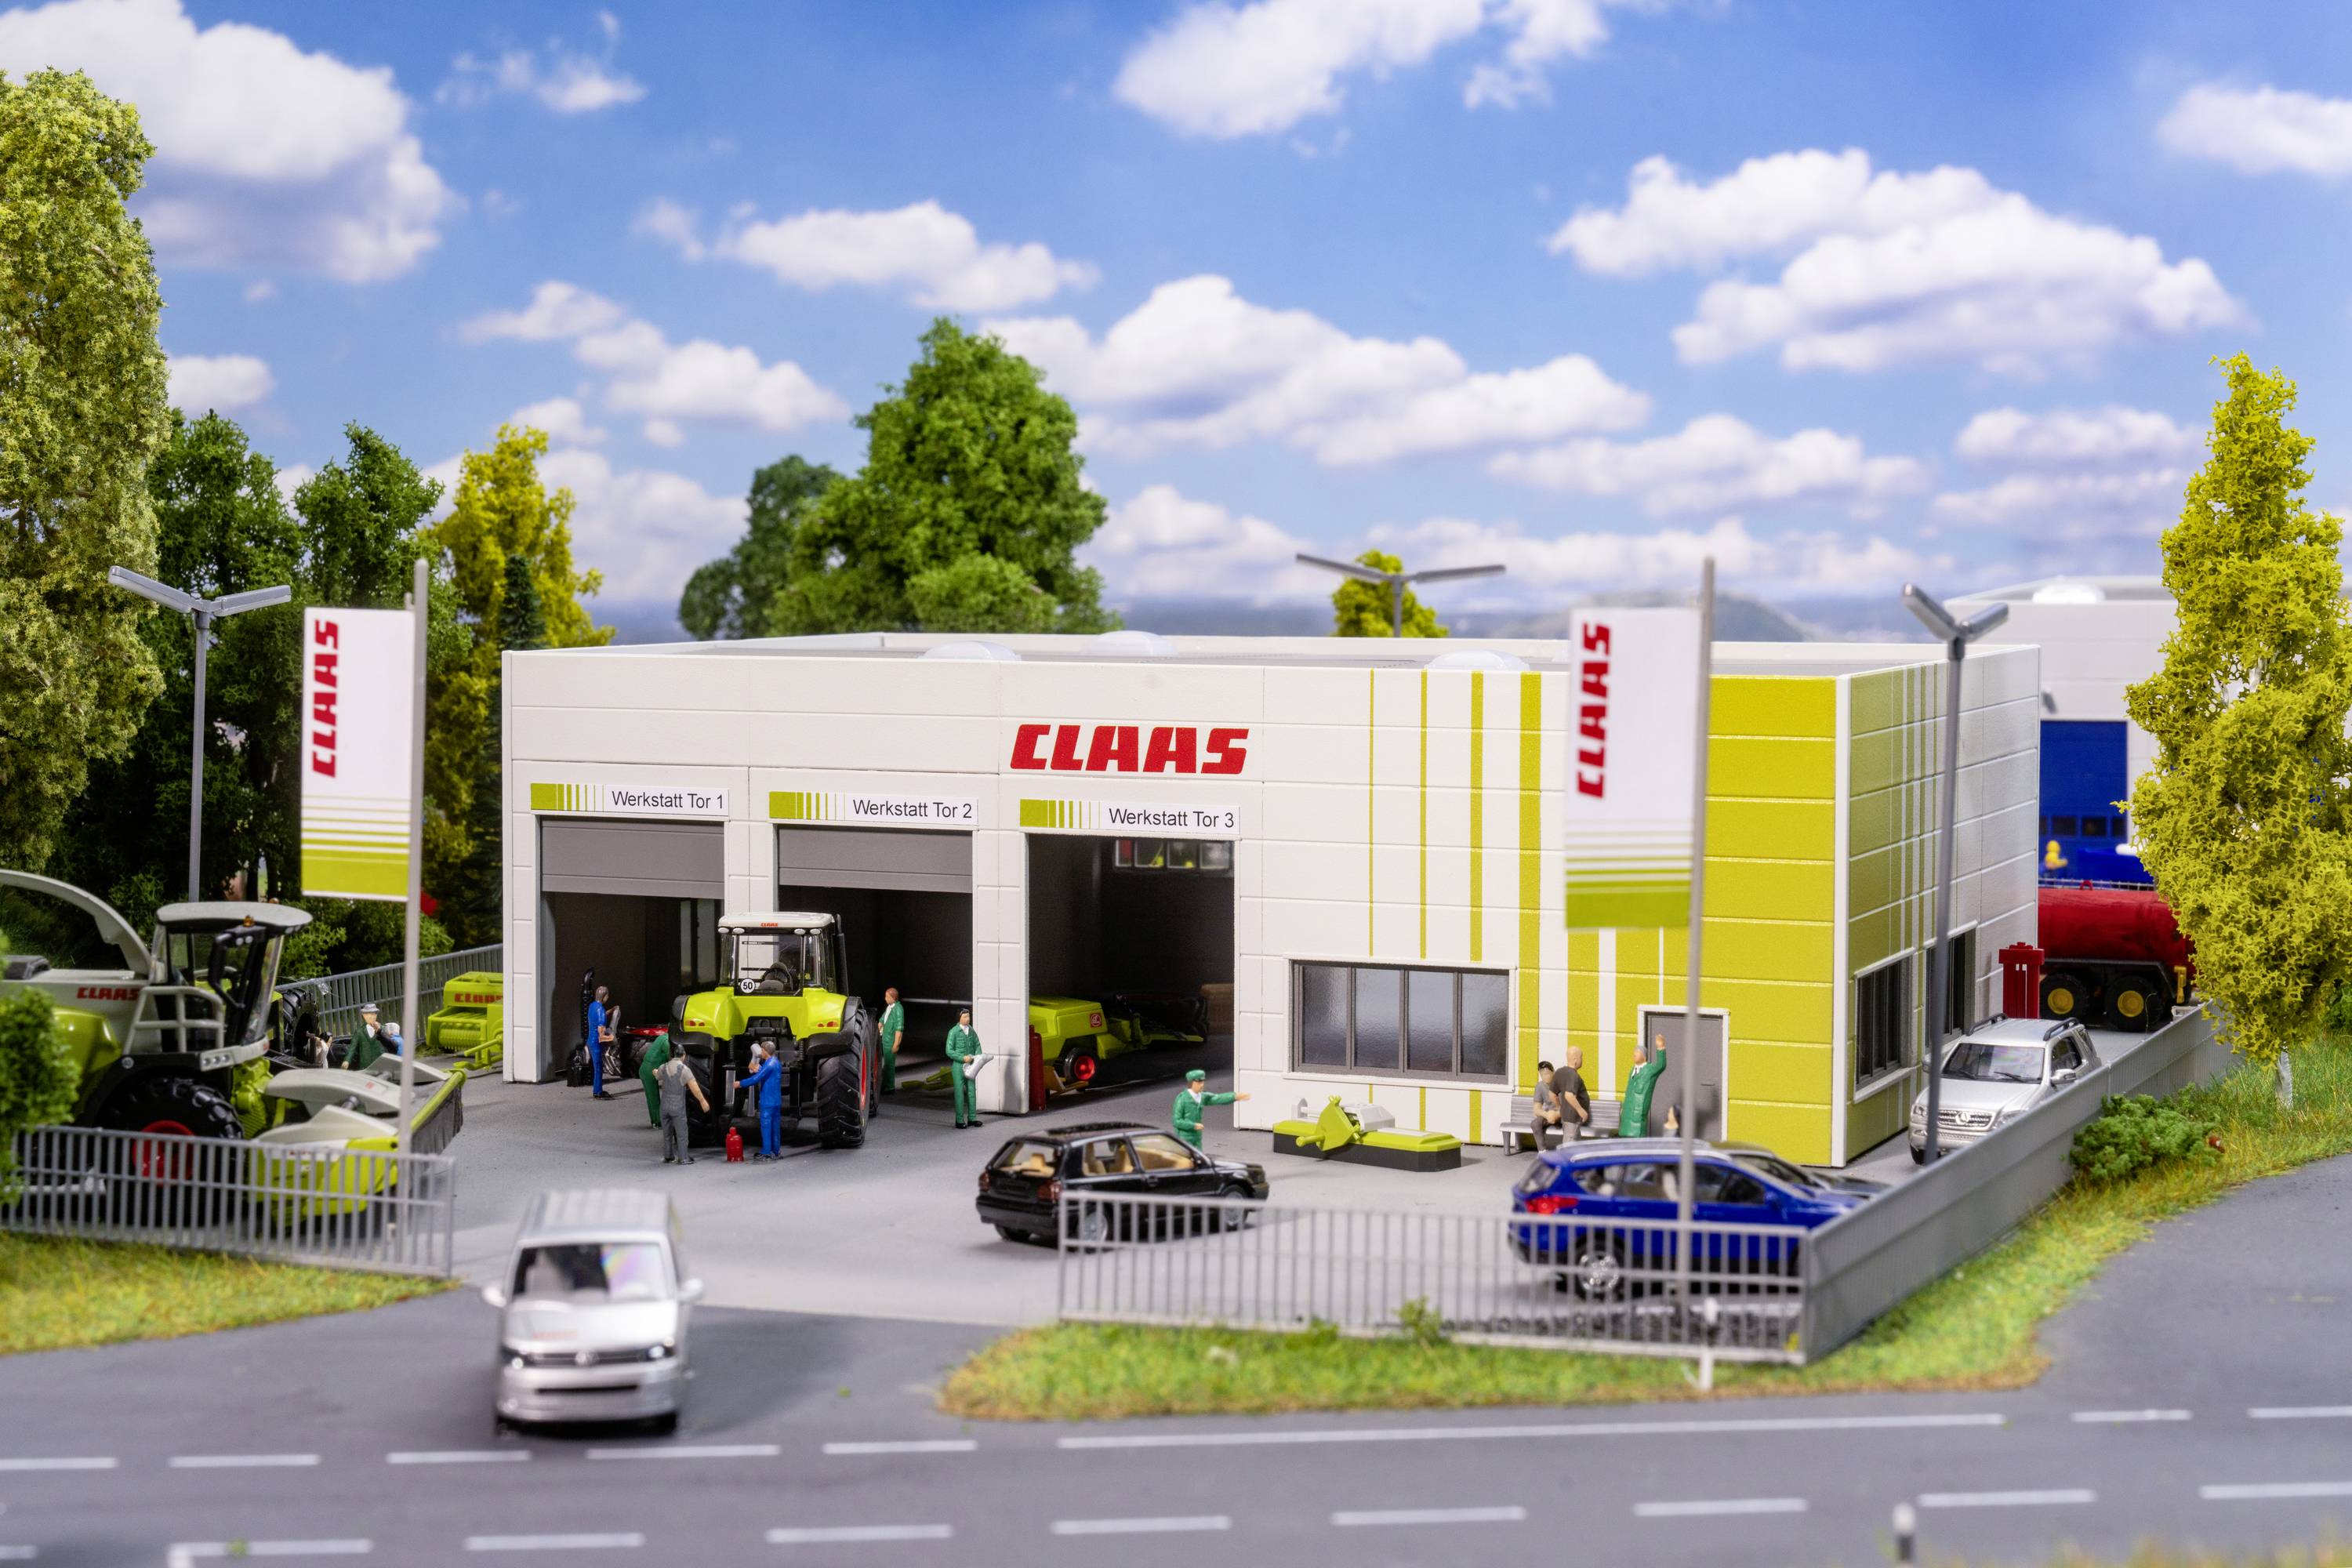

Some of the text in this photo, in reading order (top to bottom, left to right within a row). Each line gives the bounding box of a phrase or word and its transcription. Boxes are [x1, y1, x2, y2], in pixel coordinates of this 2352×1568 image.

[312, 619, 339, 778] CLAAS
[1577, 622, 1611, 799] CLAAS
[1010, 723, 1250, 775] CLAAS
[612, 790, 723, 809] Werkstatt Tor 1
[853, 799, 972, 818] Werkstatt Tor 2
[1109, 808, 1234, 828] Werkstatt Tor 3
[742, 982, 753, 990] 50
